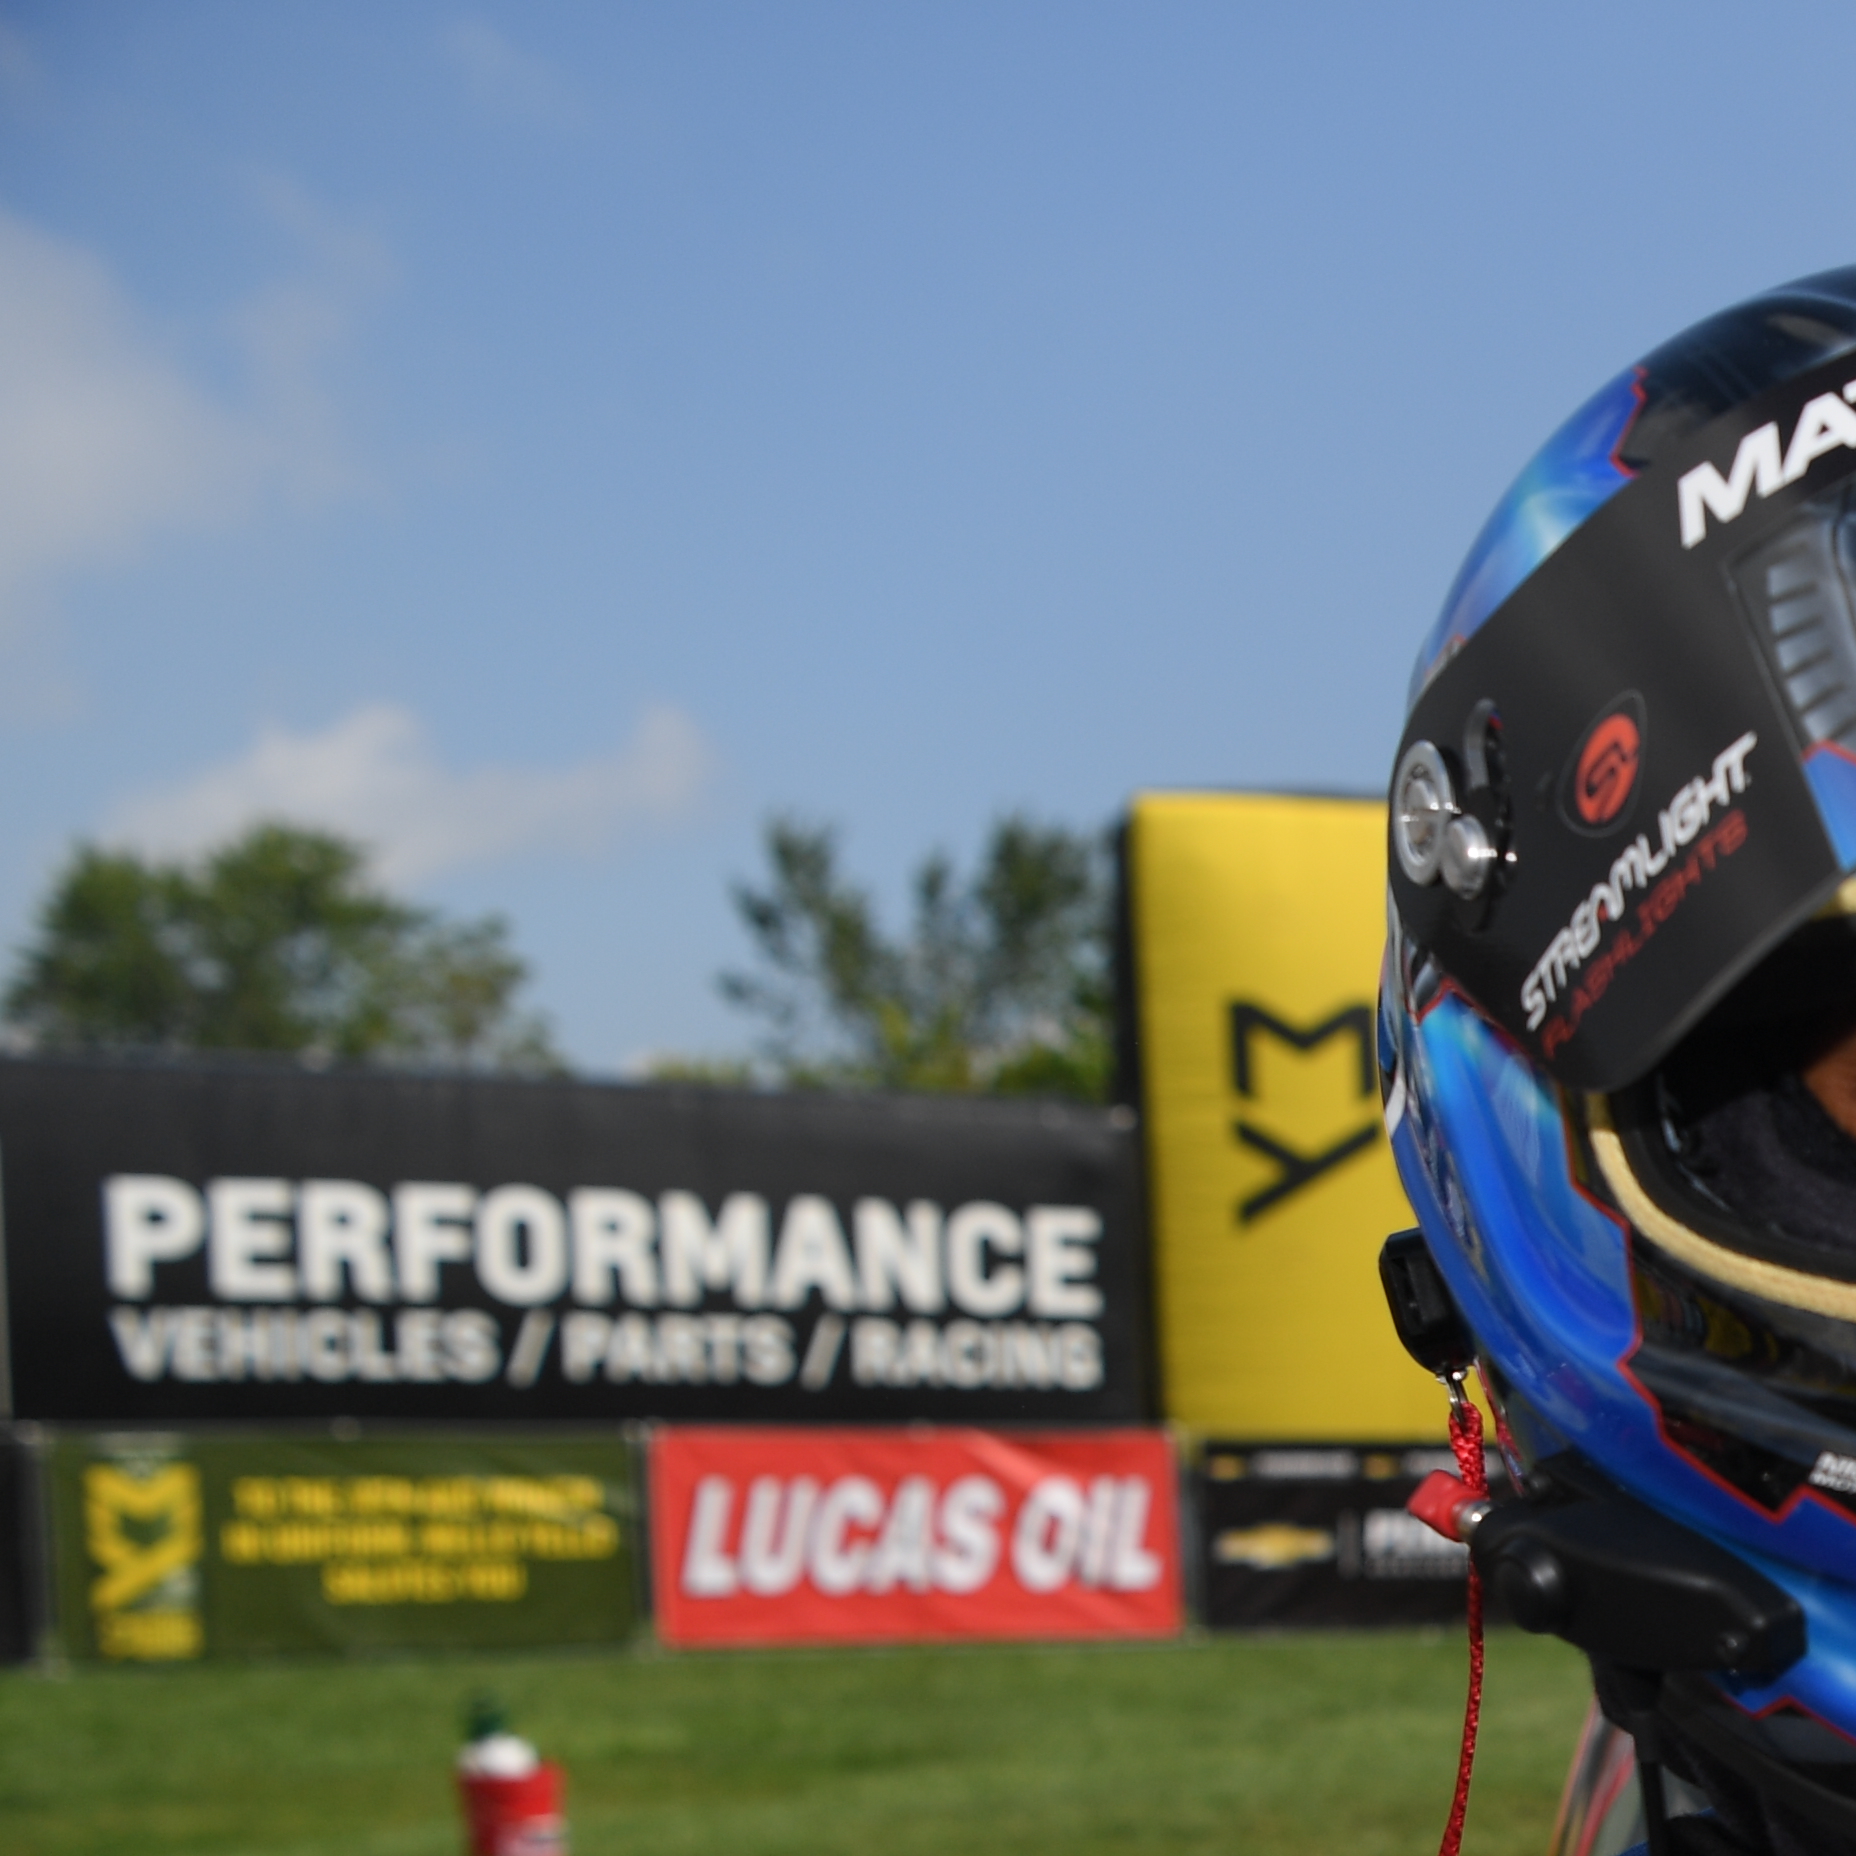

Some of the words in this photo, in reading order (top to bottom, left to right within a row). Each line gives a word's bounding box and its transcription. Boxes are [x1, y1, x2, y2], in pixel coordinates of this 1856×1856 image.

[1519, 729, 1759, 1032] STREAMLIGHT
[103, 1173, 1106, 1318] PERFORMANCE
[107, 1306, 502, 1386] VEHICLES
[561, 1311, 797, 1388] PARTS
[851, 1317, 1105, 1393] RACING
[682, 1472, 1004, 1598] LUCAS
[1008, 1474, 1164, 1593] OIL
